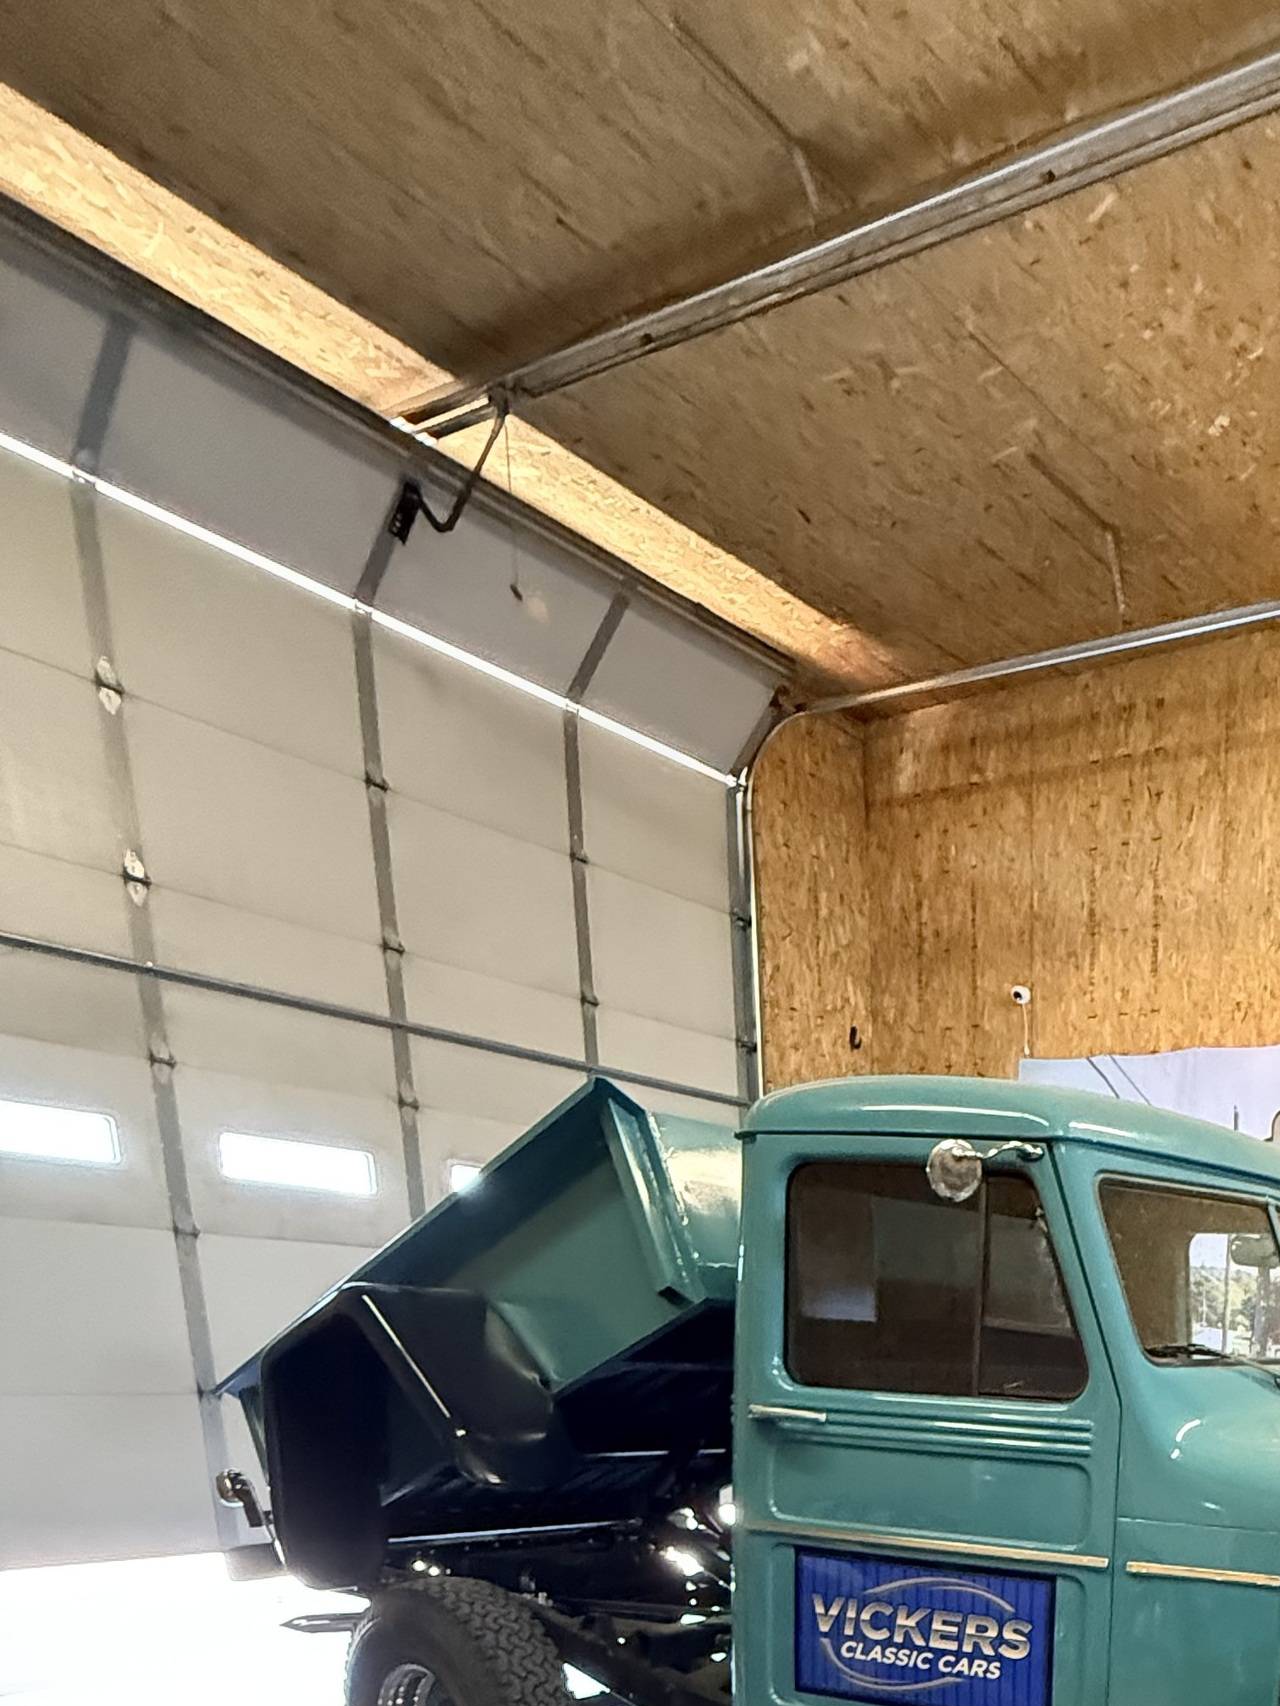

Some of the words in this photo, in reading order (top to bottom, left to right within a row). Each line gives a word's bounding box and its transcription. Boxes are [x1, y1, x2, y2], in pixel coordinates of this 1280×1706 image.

[812, 1593, 1033, 1660] VICKERS
[840, 1641, 934, 1670] CLASSIC
[938, 1656, 1001, 1680] CARS
